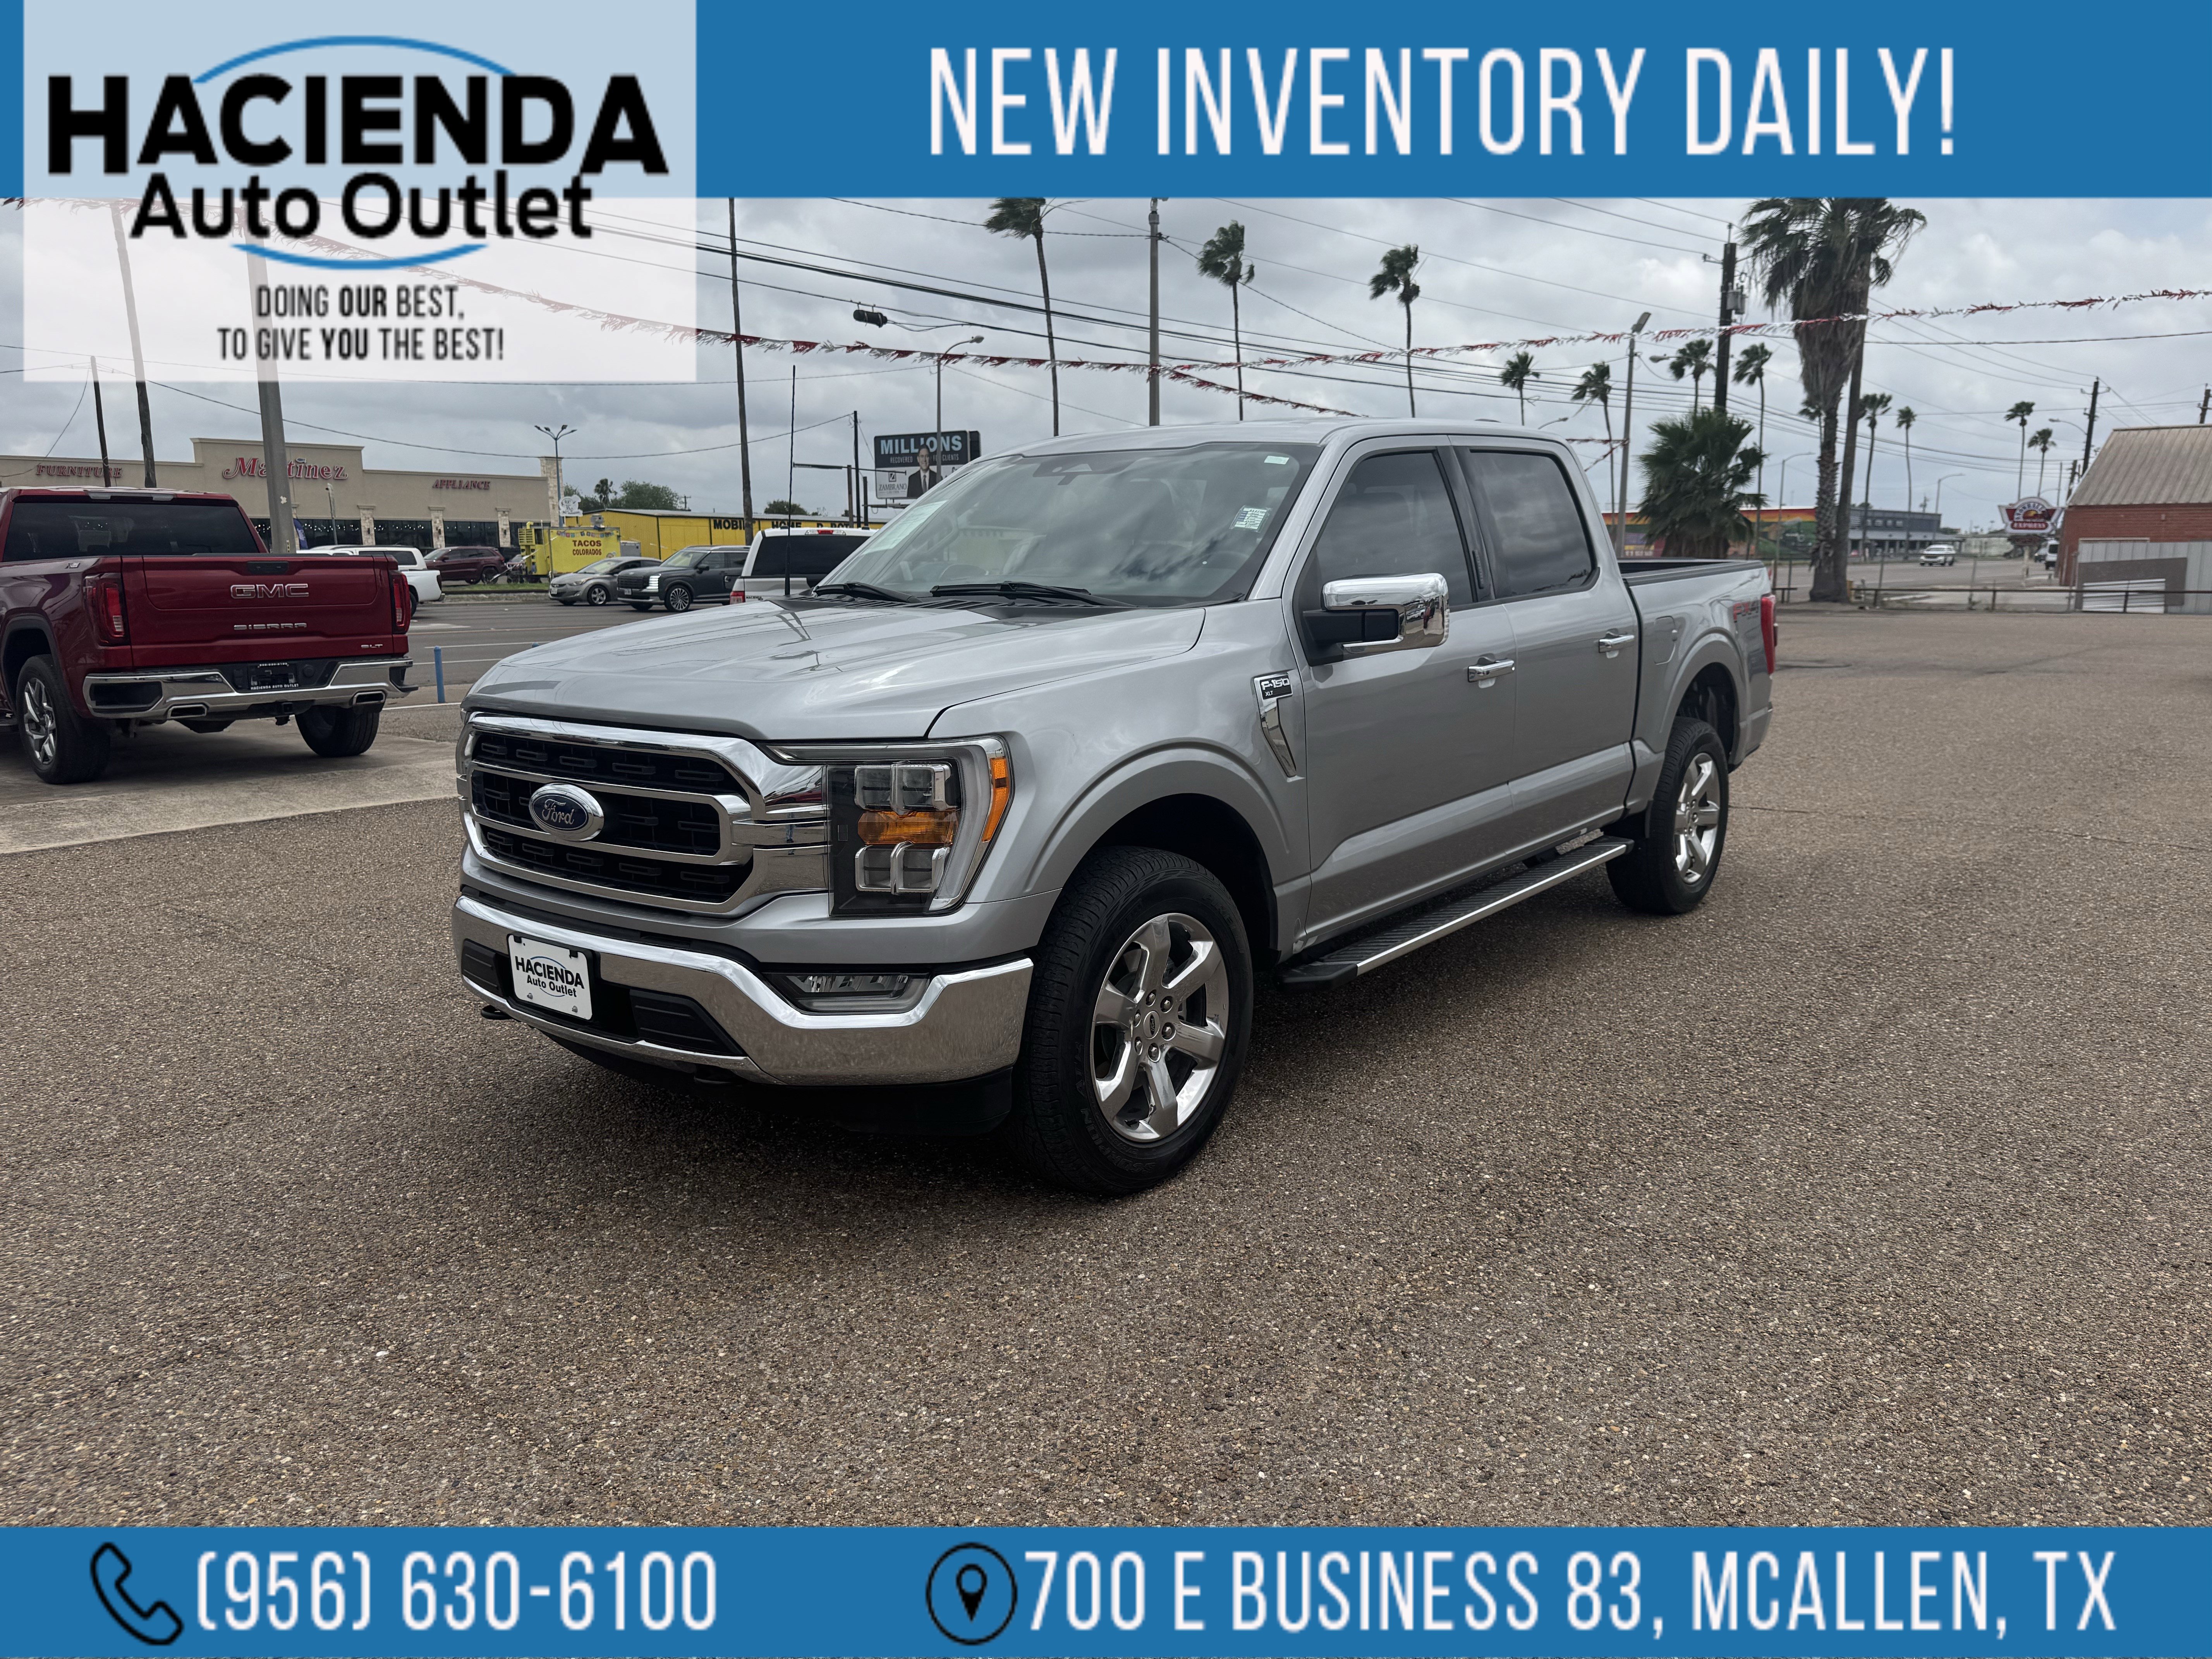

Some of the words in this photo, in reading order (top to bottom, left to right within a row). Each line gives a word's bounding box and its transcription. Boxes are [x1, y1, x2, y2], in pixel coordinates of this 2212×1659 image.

[880, 435, 962, 455] MILLIONS
[223, 457, 349, 479] Matinez
[432, 479, 490, 489] APPLIANCE
[713, 519, 756, 530] MOBI
[231, 583, 309, 599] GMC
[1733, 598, 1759, 622] FX4
[1261, 678, 1290, 690] F-150
[542, 799, 574, 825] Ford
[515, 956, 585, 989] HACIENDA
[527, 975, 546, 988] Auto
[549, 981, 577, 998] Outlet
